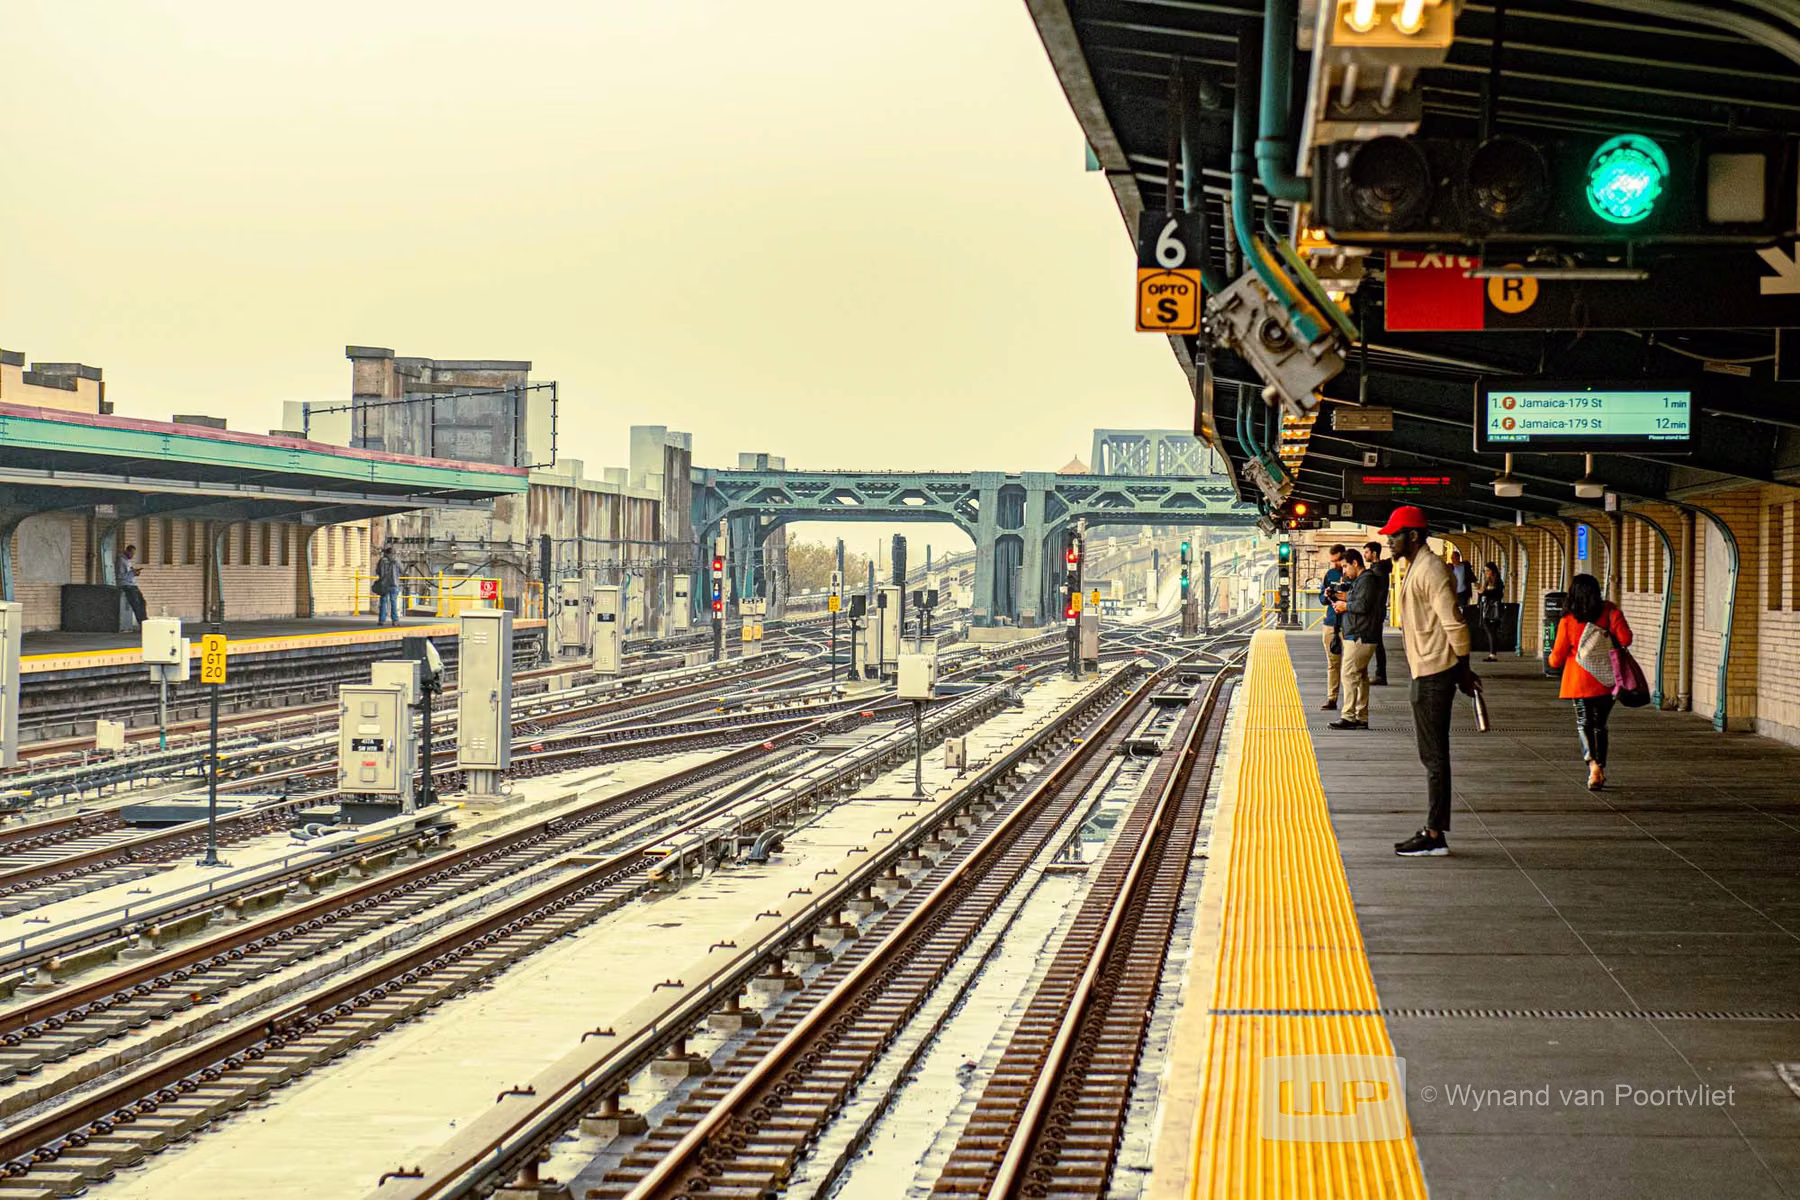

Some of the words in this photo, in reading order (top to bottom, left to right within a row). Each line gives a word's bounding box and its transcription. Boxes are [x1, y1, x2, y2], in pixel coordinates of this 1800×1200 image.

[1156, 219, 1187, 268] 6
[1147, 284, 1189, 296] OPTO
[1502, 277, 1524, 301] R
[1156, 298, 1178, 322] S
[1519, 398, 1589, 409] Jamaica-179
[1591, 398, 1603, 409] St
[1663, 397, 1669, 409] 1
[1671, 401, 1687, 409] min
[1519, 418, 1588, 429] Jamaica-179
[1590, 418, 1602, 429] St
[1655, 417, 1670, 429] 12
[1670, 421, 1687, 429] min
[210, 640, 218, 651] D
[208, 654, 222, 664] GT
[206, 666, 222, 678] 20
